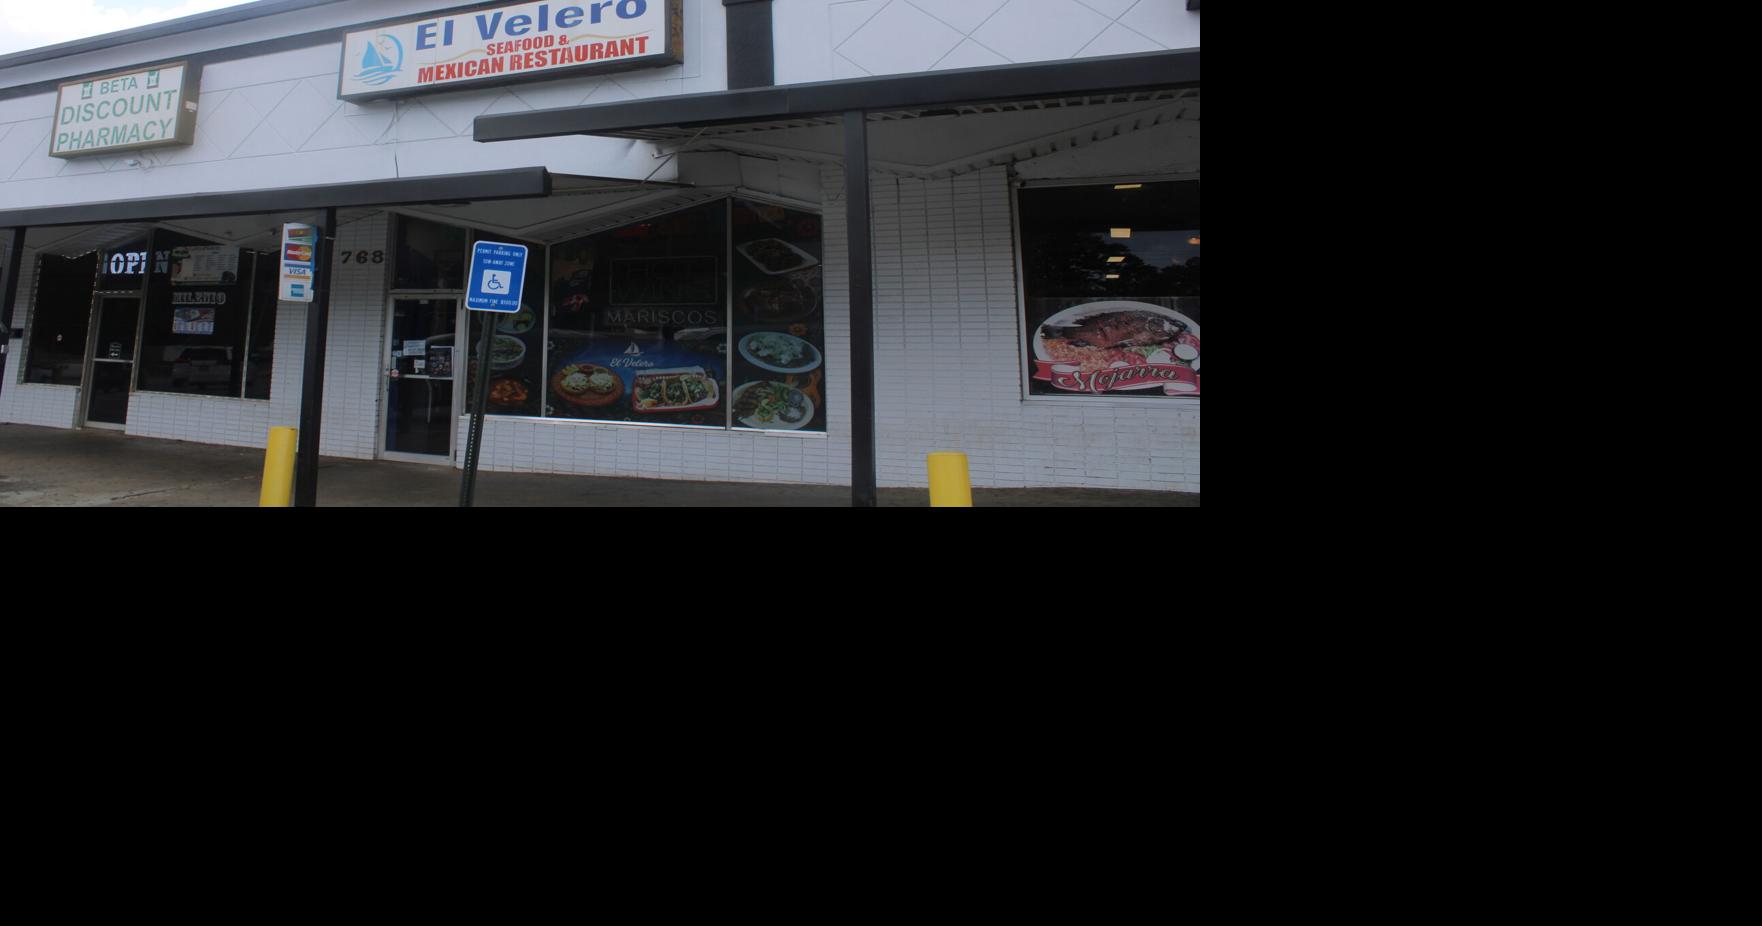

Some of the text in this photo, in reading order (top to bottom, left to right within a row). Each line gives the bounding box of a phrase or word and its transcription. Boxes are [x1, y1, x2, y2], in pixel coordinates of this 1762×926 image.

[415, 0, 648, 51] El Velero
[486, 34, 570, 56] SEAFOOD &
[416, 36, 649, 84] MEXICAN RESTAURANT
[100, 76, 138, 95] BETA
[60, 89, 177, 126] DISCOUNT
[56, 118, 174, 152] PHARMACY
[340, 250, 384, 264] 768
[288, 267, 307, 275] VISA
[607, 309, 719, 325] MARISCOS
[1058, 366, 1178, 394] Mojarra
